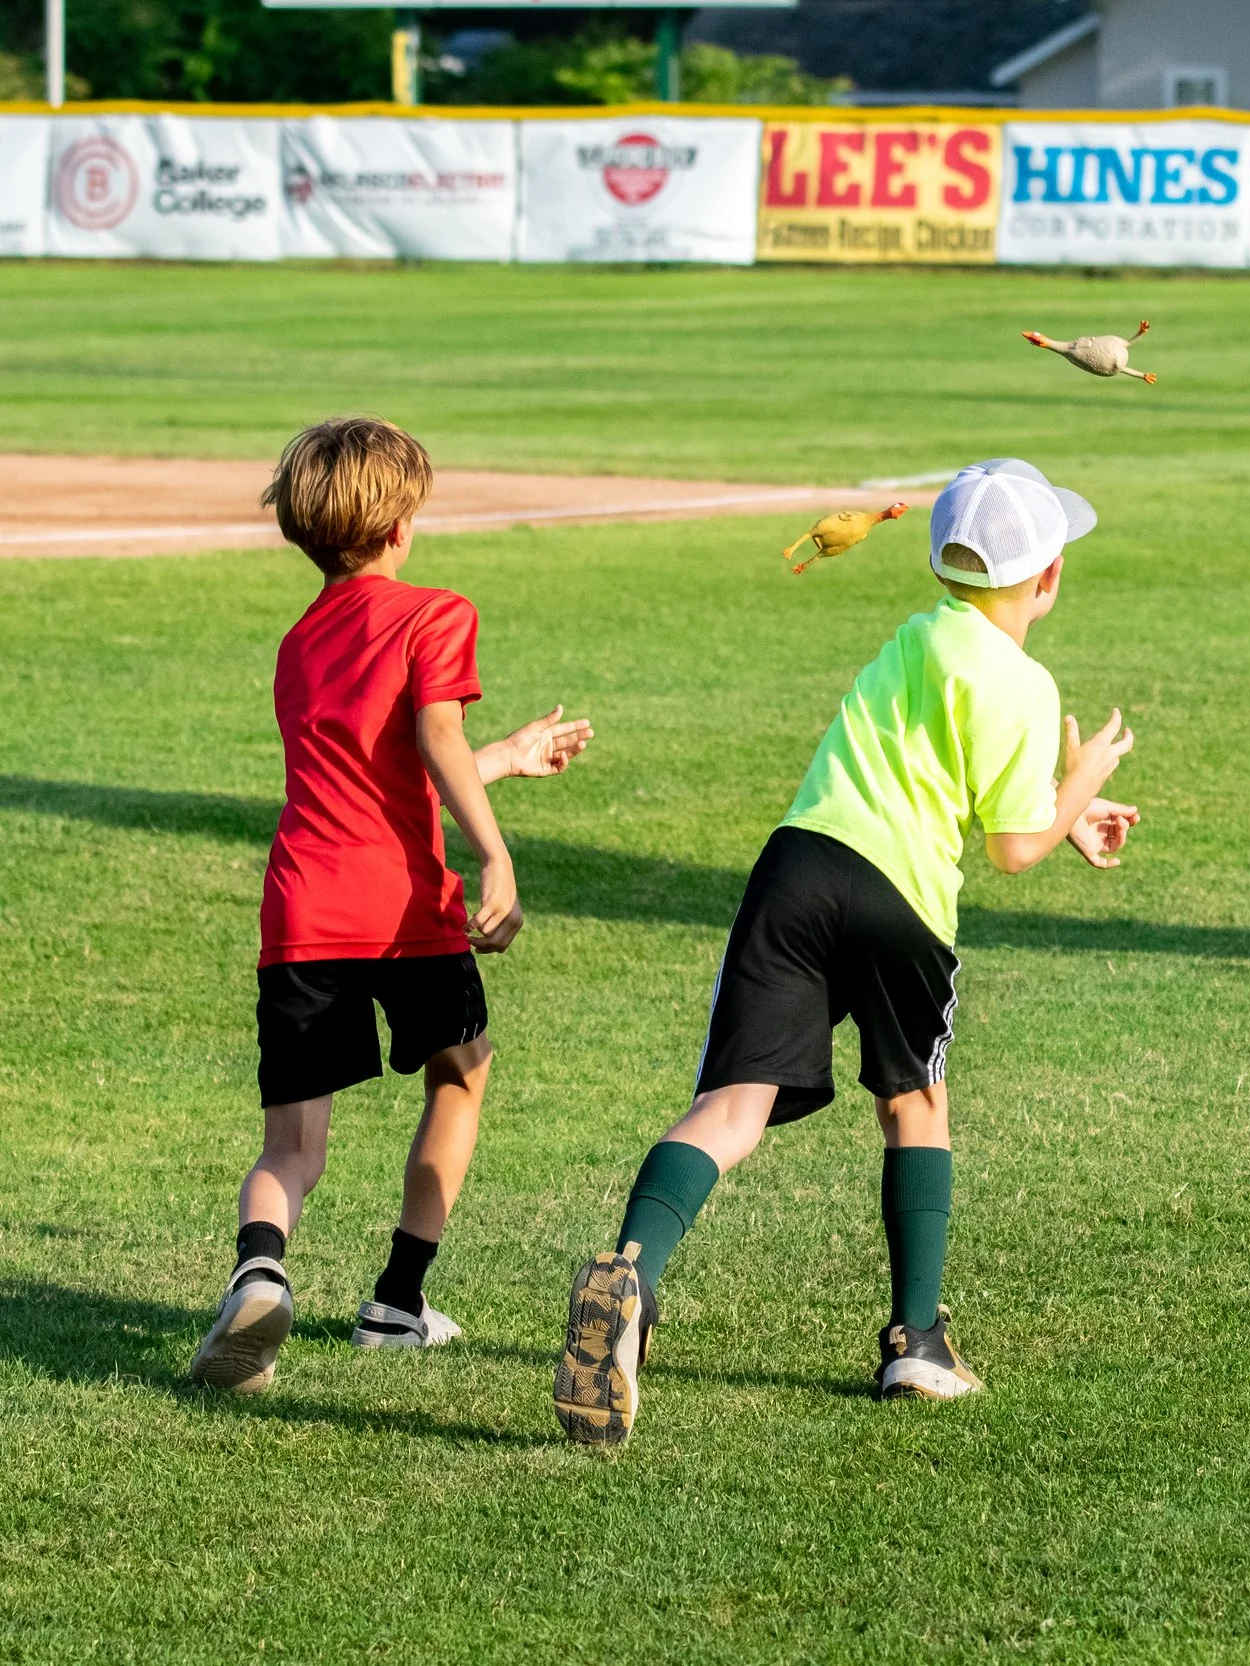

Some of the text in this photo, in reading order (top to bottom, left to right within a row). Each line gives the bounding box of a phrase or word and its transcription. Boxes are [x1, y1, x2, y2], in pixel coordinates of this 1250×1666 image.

[766, 129, 993, 211] LEE'S
[1011, 145, 1240, 207] HINES
[153, 188, 267, 221] College
[1008, 213, 1241, 242] CORPORATION
